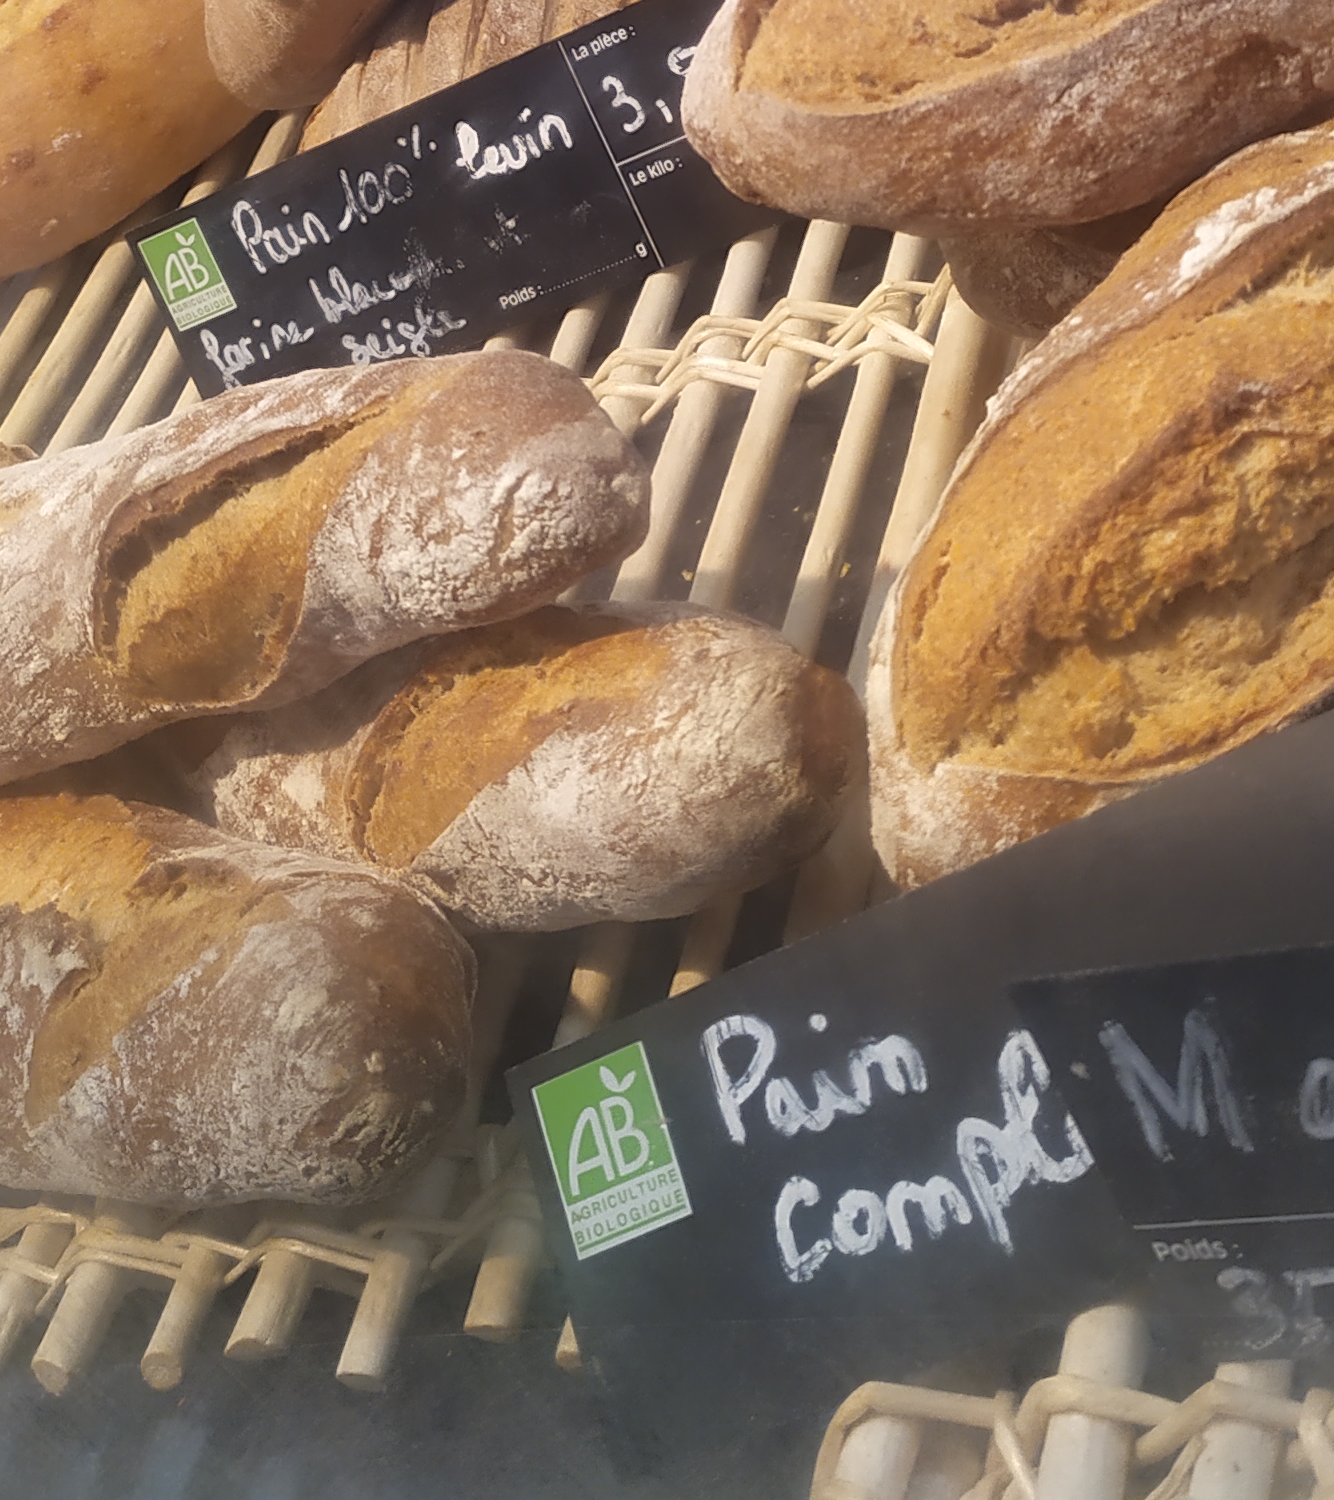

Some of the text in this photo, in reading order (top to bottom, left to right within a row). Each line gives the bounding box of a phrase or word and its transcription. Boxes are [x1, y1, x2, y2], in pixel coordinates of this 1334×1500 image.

[571, 45, 589, 61] La
[592, 27, 628, 55] pièce
[628, 169, 646, 188] Le
[649, 159, 675, 179] kilo
[231, 200, 332, 274] Pain
[165, 247, 209, 300] AB
[172, 285, 227, 314] AGRICULTURE
[176, 295, 232, 325] BIOLOGIQUE
[499, 287, 537, 310] Poids
[701, 1012, 929, 1145] Pain
[569, 1095, 650, 1196] AB
[571, 1167, 680, 1225] AGRICULTURE
[573, 1189, 685, 1246] BIOLOGIQUE
[1153, 1238, 1227, 1262] Poids
